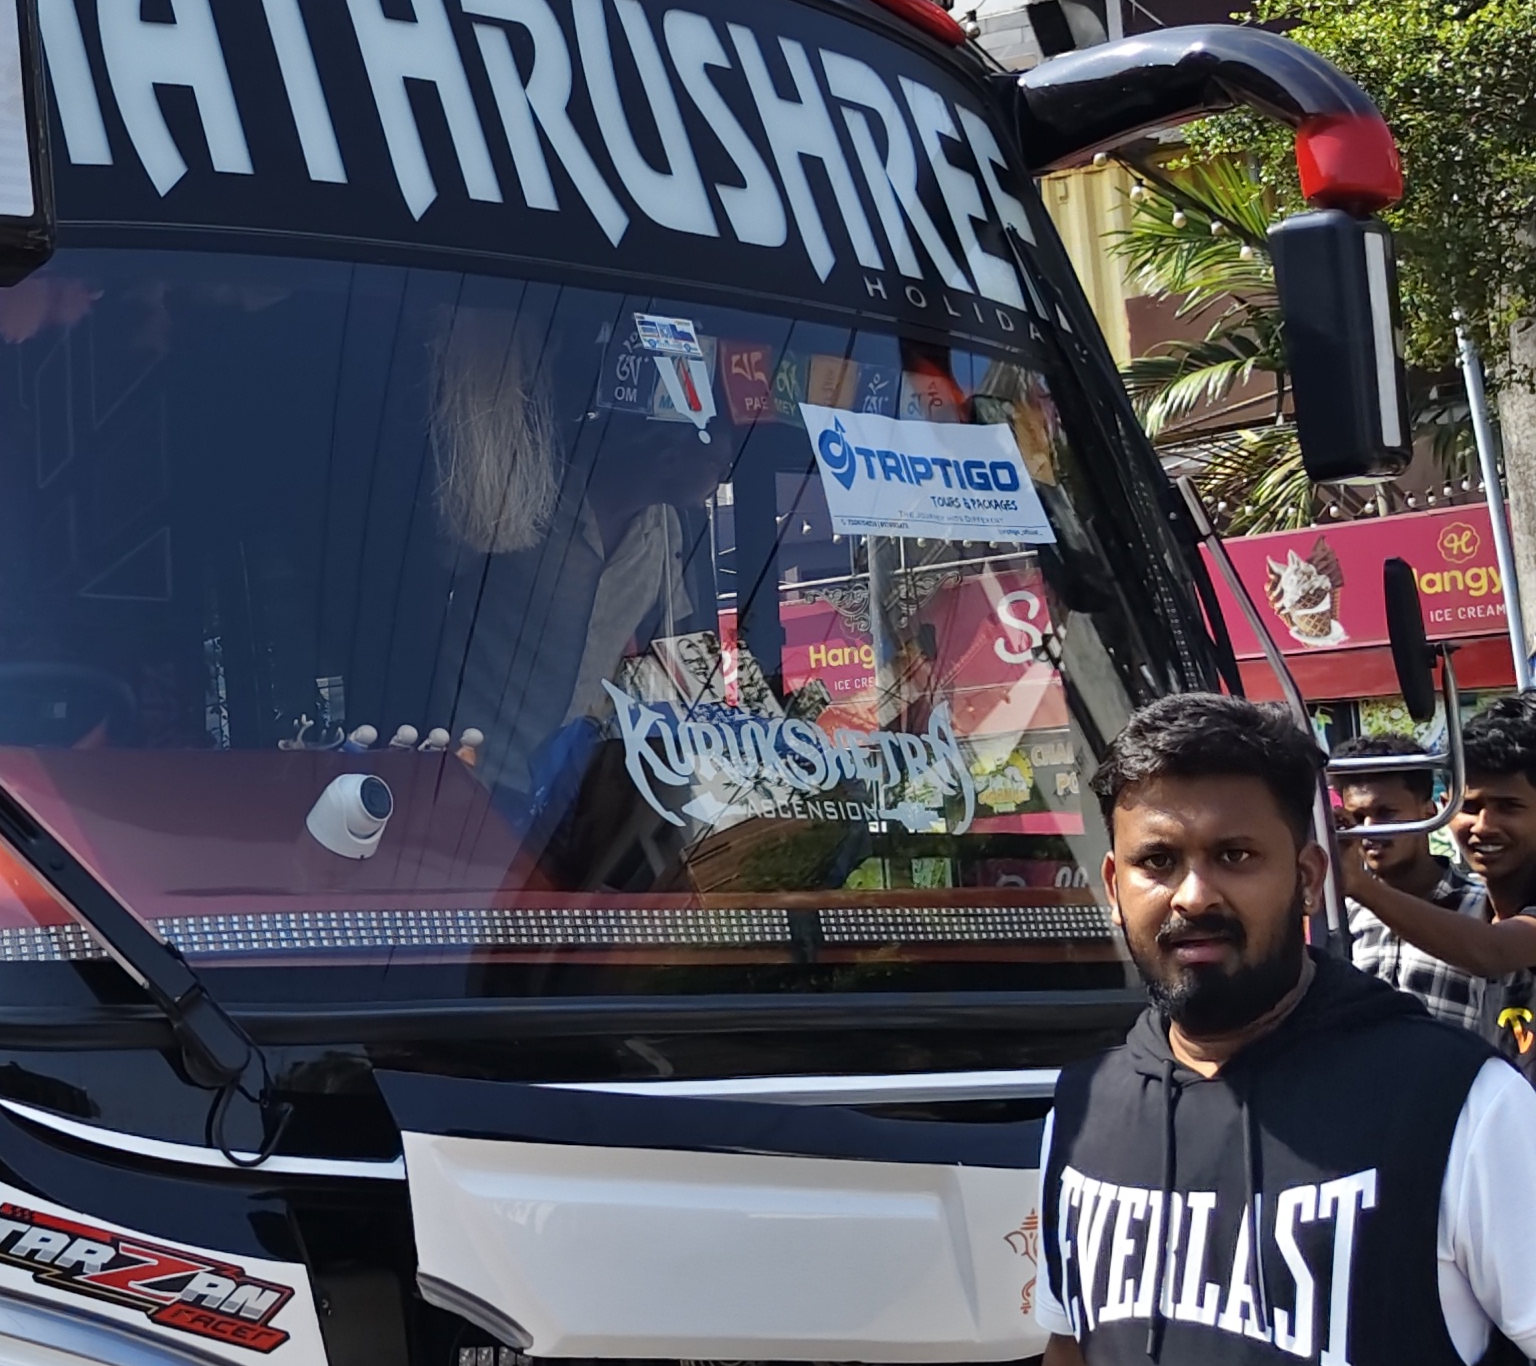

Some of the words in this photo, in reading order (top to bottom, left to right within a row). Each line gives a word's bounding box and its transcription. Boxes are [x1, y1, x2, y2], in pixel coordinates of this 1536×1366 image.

[614, 386, 637, 402] OM
[854, 446, 1020, 492] TRIPTIGO
[930, 496, 962, 509] TOURS
[971, 498, 1018, 511] PACKAGES
[1412, 566, 1503, 597] angy
[1429, 608, 1453, 623] ICE
[834, 679, 851, 691] ICE
[746, 798, 879, 822] ASCENSION
